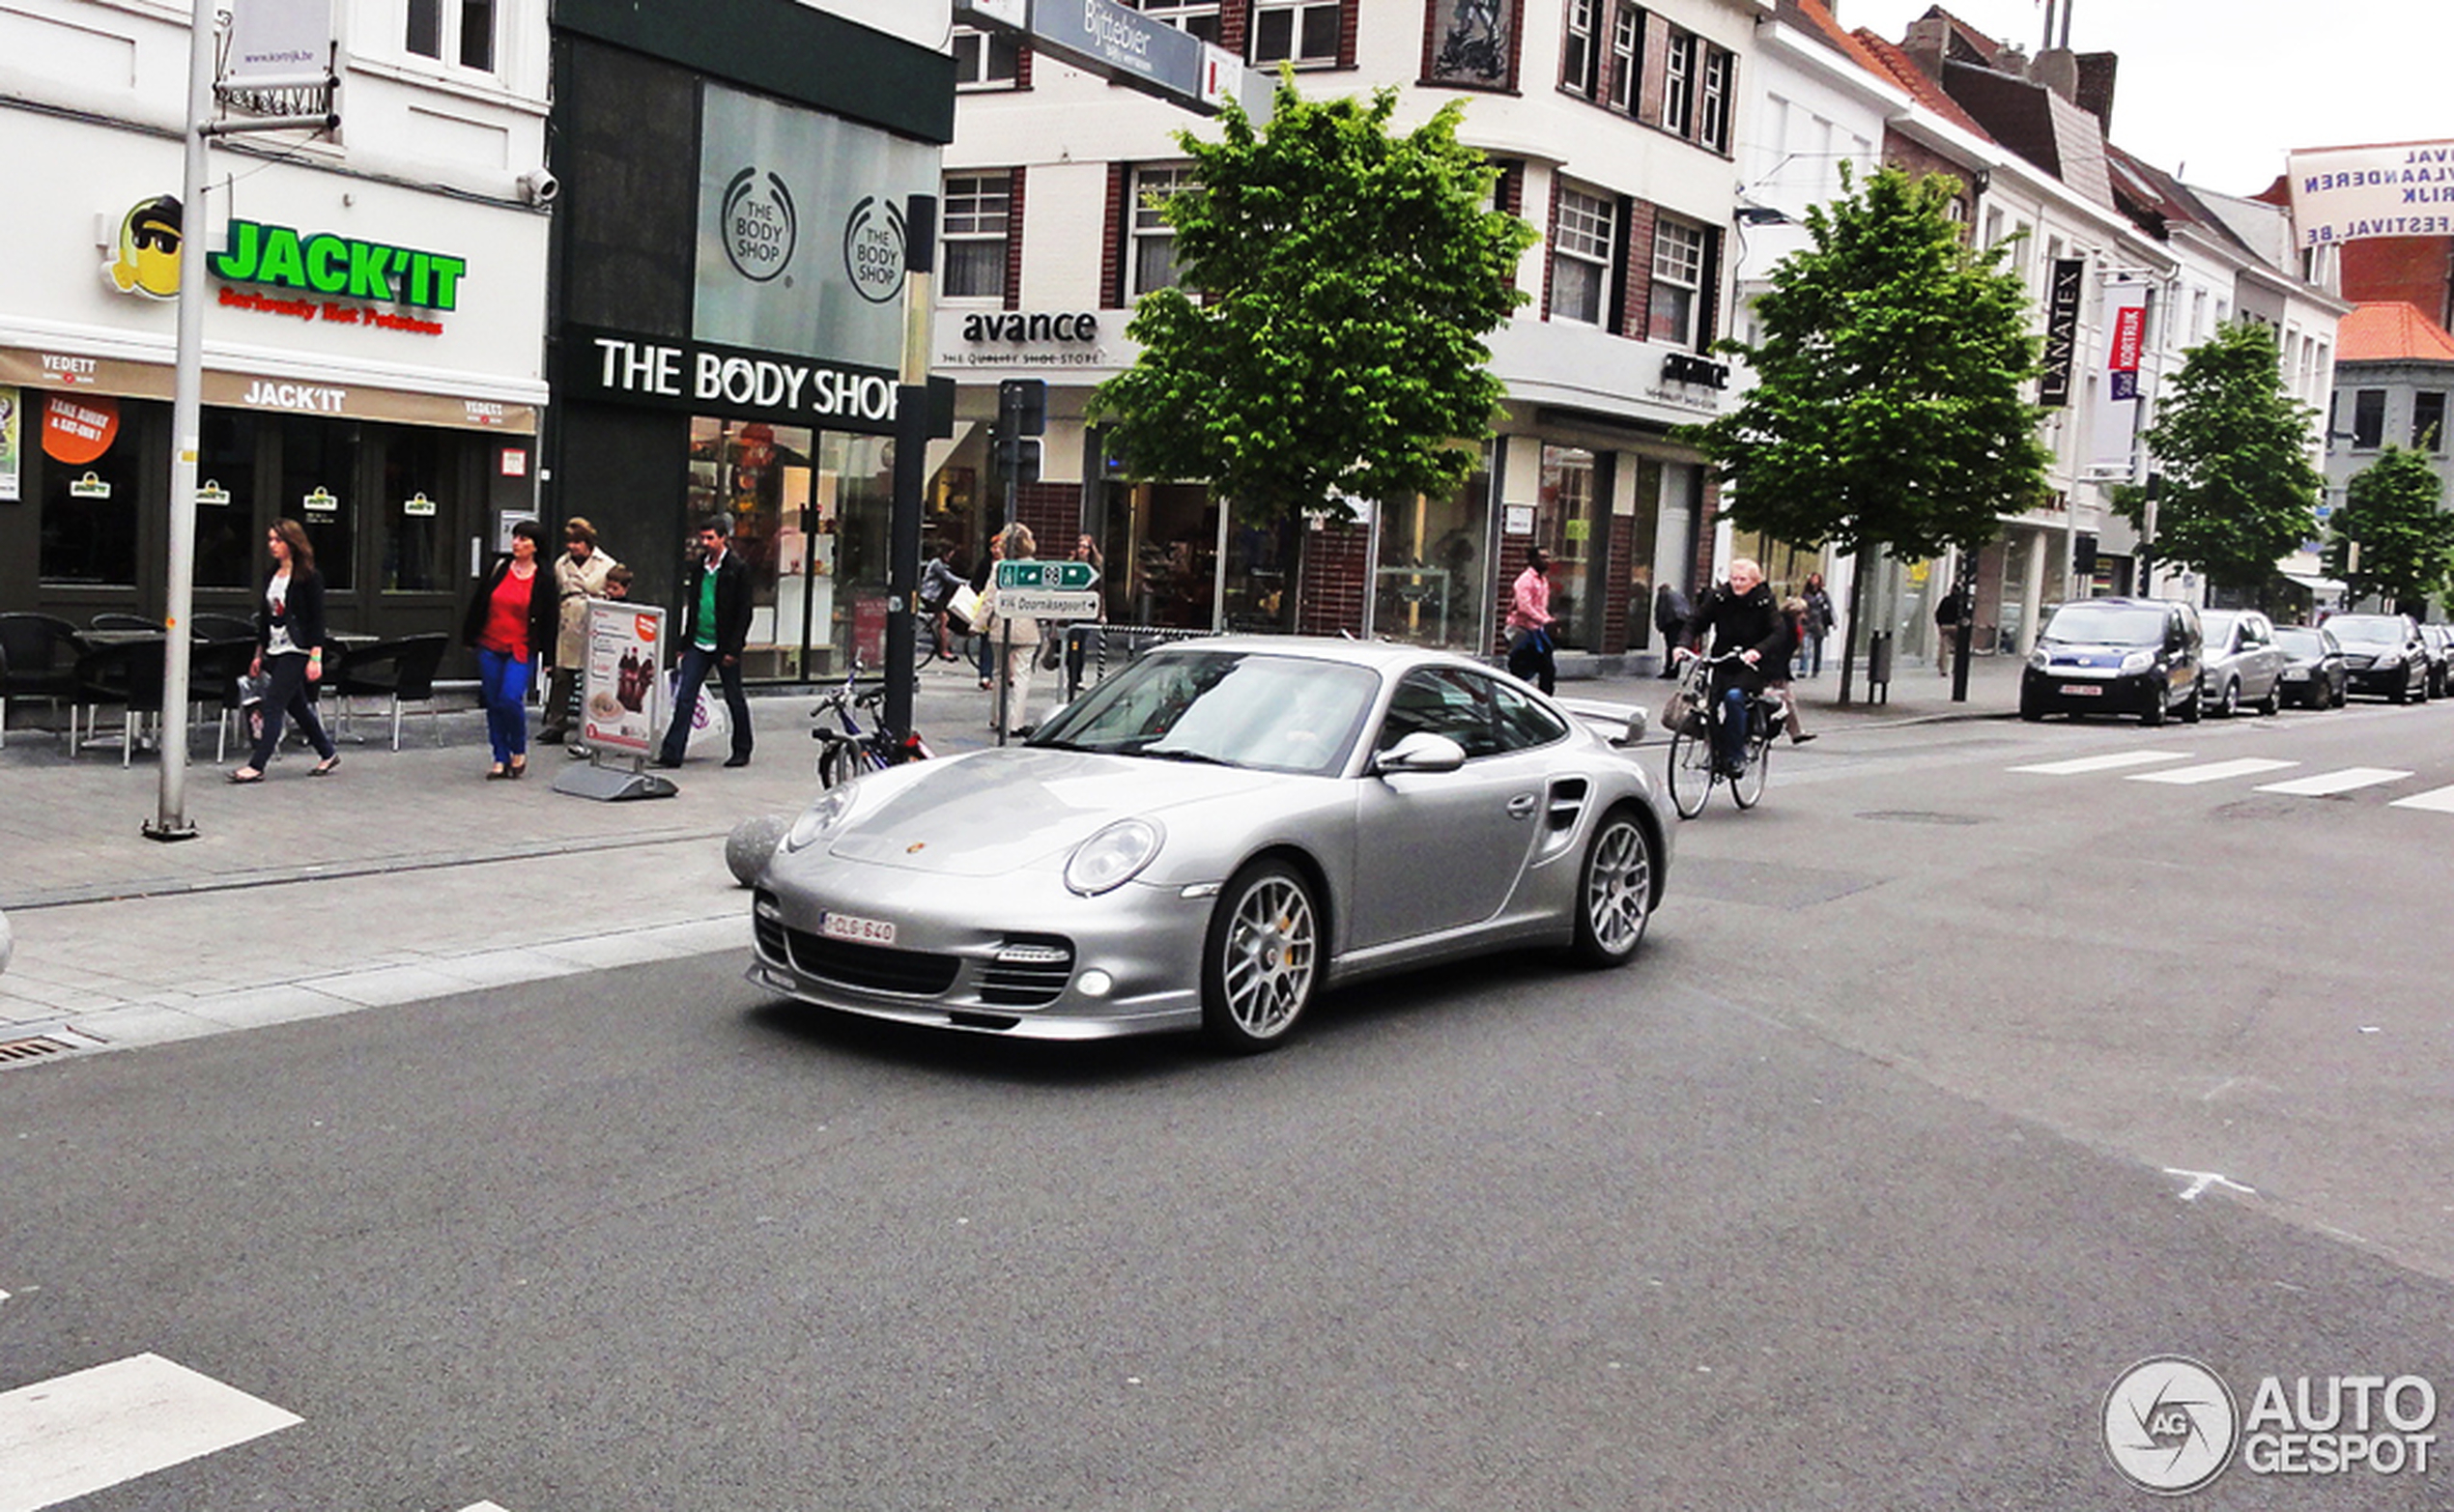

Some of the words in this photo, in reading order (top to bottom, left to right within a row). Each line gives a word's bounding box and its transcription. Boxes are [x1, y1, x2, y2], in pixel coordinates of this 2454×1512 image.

[747, 200, 773, 221] THE
[735, 217, 784, 242] BODY
[866, 228, 890, 246] THE
[737, 239, 781, 262] SHOP
[856, 244, 899, 267] BODY
[209, 219, 466, 311] JACK'IT
[858, 265, 897, 285] SHOP
[218, 287, 318, 322] Seriously
[322, 301, 359, 324] Hot
[963, 312, 1099, 342] avance
[2043, 272, 2078, 394] LANATEX
[43, 355, 97, 374] VEDETT
[942, 354, 963, 364] THE
[968, 354, 1017, 365] QUALITY
[1024, 354, 1056, 364] SHOE
[1060, 354, 1099, 364] STORE
[594, 338, 682, 396] THE
[695, 352, 809, 410] BODY
[244, 381, 346, 413] JACK'IT
